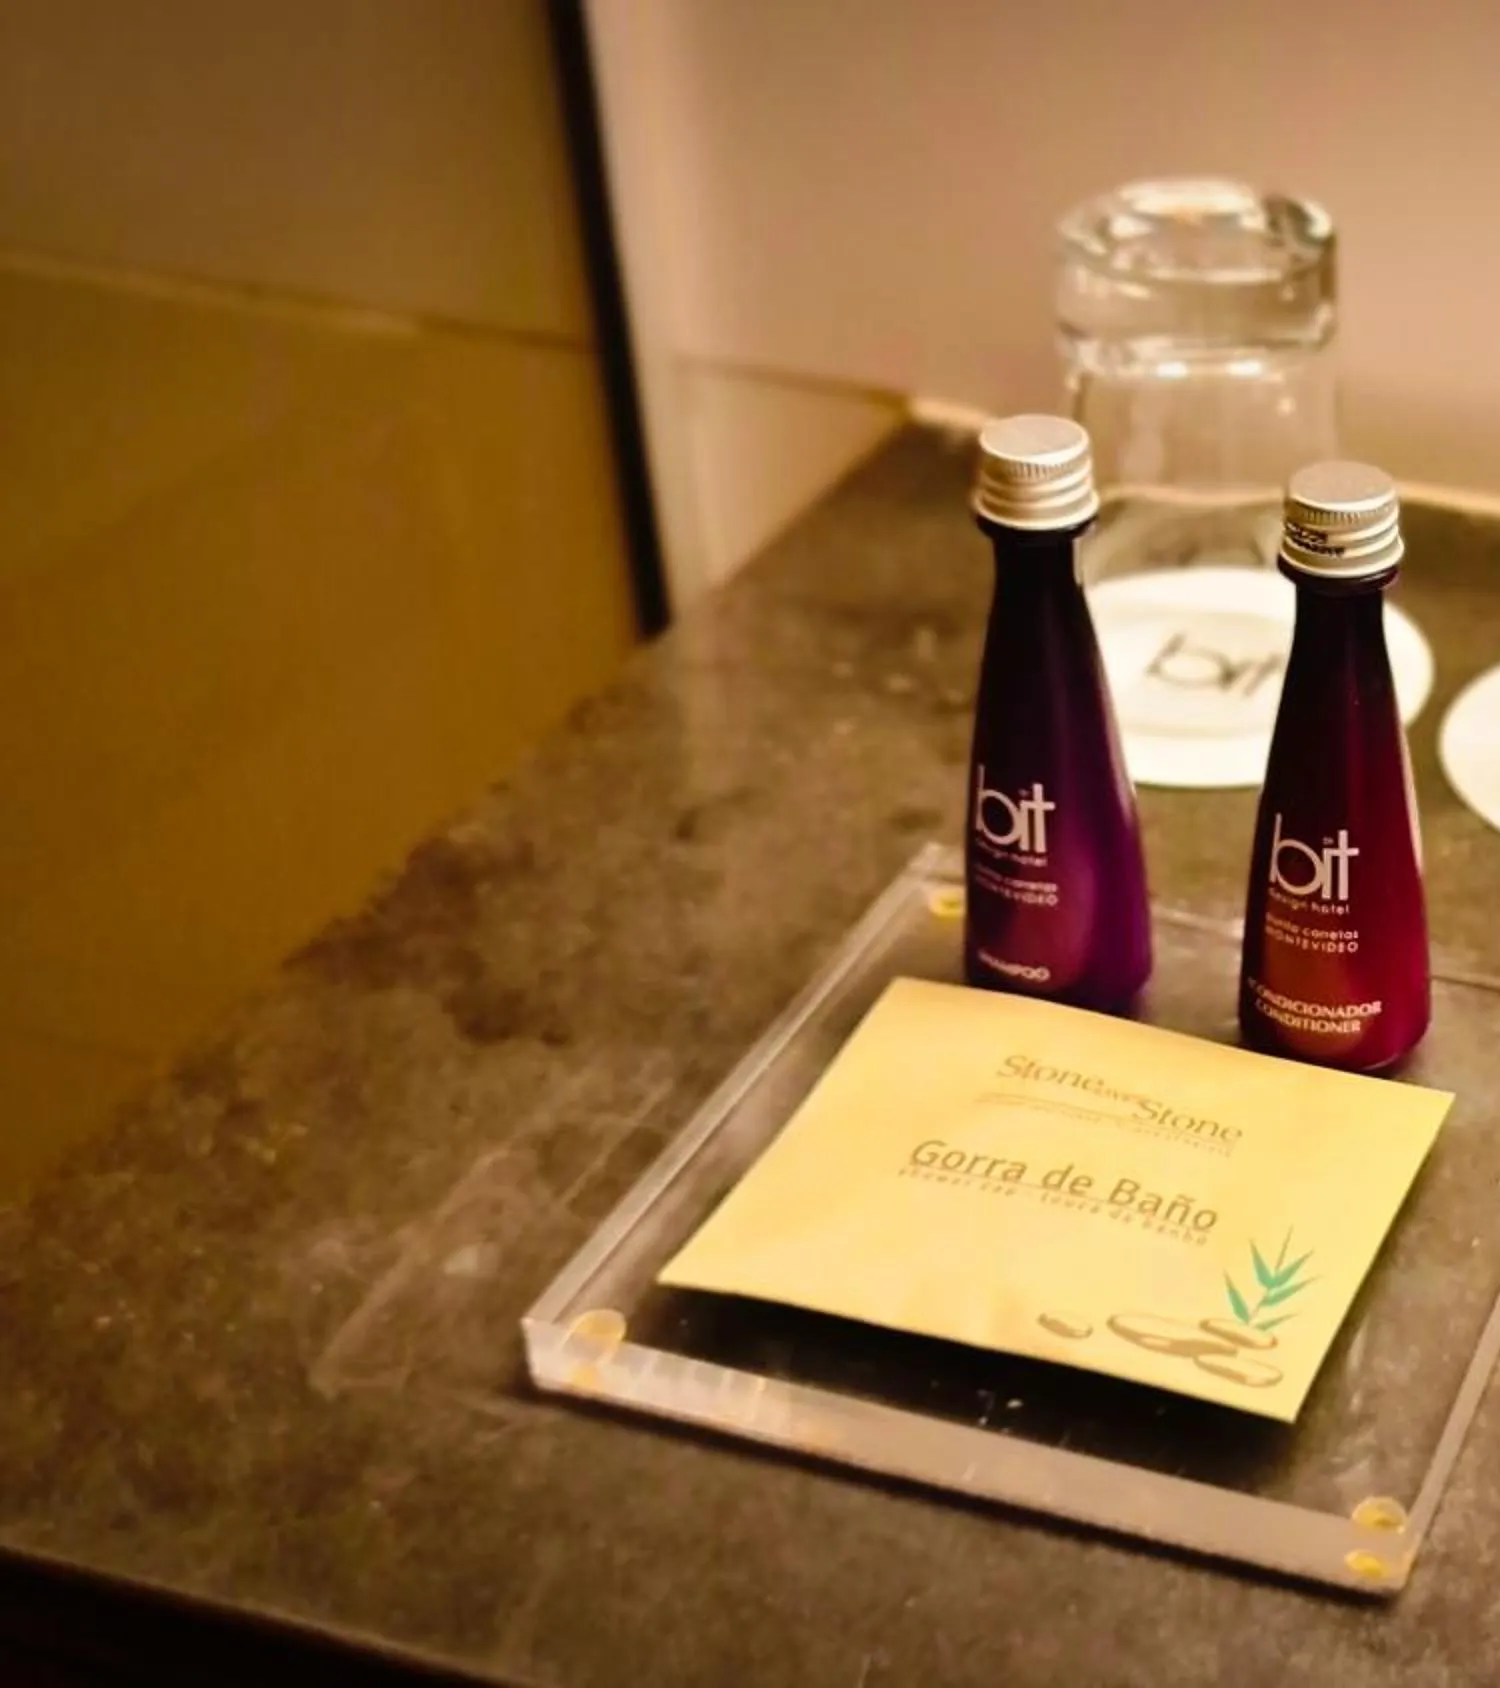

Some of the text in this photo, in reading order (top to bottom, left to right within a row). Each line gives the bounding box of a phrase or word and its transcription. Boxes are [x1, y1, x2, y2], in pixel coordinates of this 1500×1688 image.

[975, 764, 1056, 853] bit
[1270, 812, 1360, 900] bit
[1255, 998, 1361, 1033] CONDITIONER
[995, 1054, 1104, 1092] Stone
[1131, 1098, 1243, 1142] Stone
[910, 1139, 1219, 1232] Gorra de Baño
